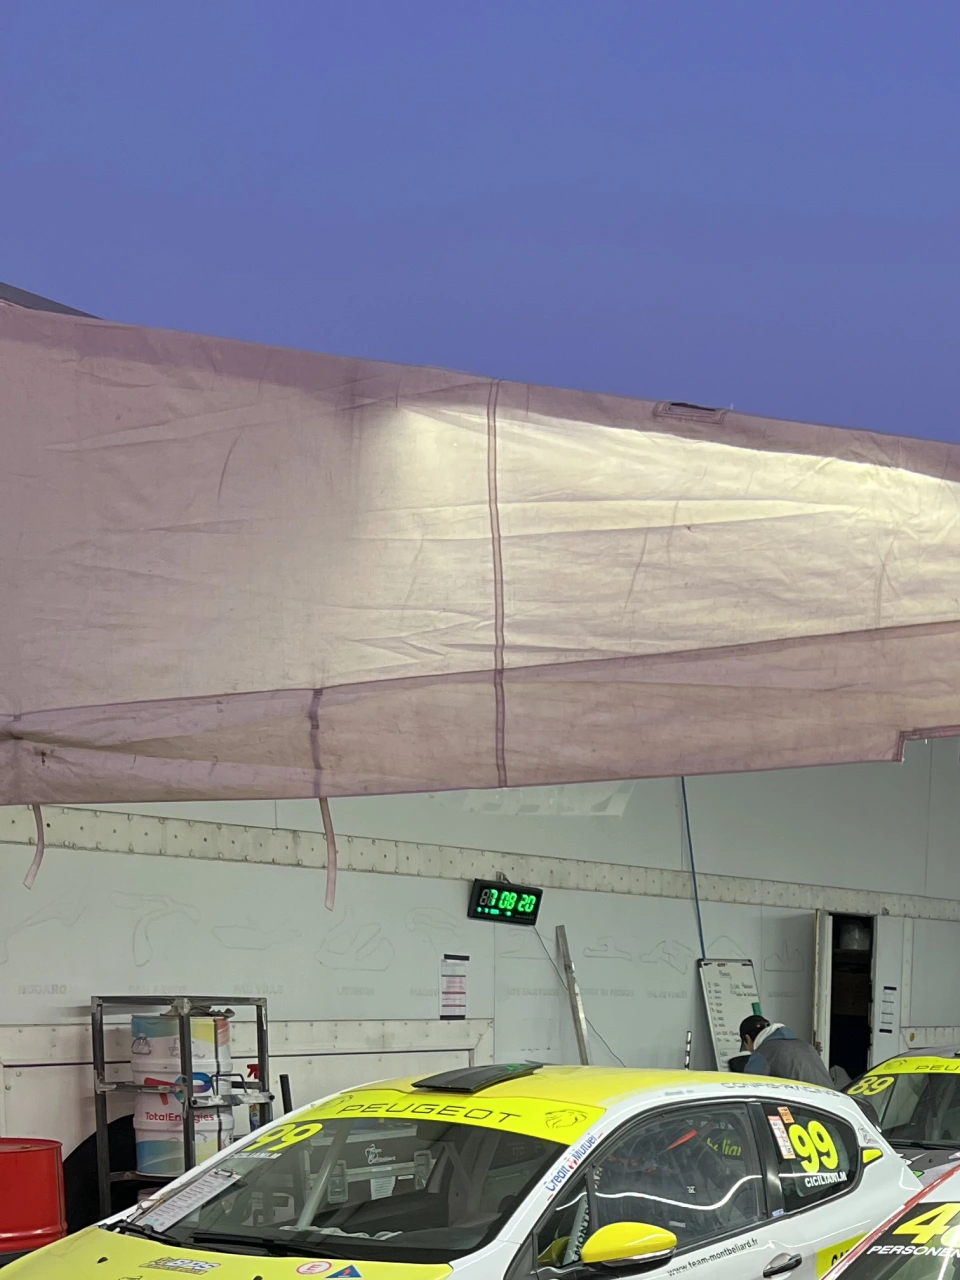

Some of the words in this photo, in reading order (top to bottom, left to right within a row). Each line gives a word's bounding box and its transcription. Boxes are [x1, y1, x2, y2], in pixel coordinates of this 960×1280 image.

[847, 1076, 895, 1096] 89
[145, 1112, 215, 1123] TotalEngies
[337, 1102, 521, 1123] PEUGEOT
[242, 1123, 322, 1152] 99
[788, 1120, 839, 1173] 99
